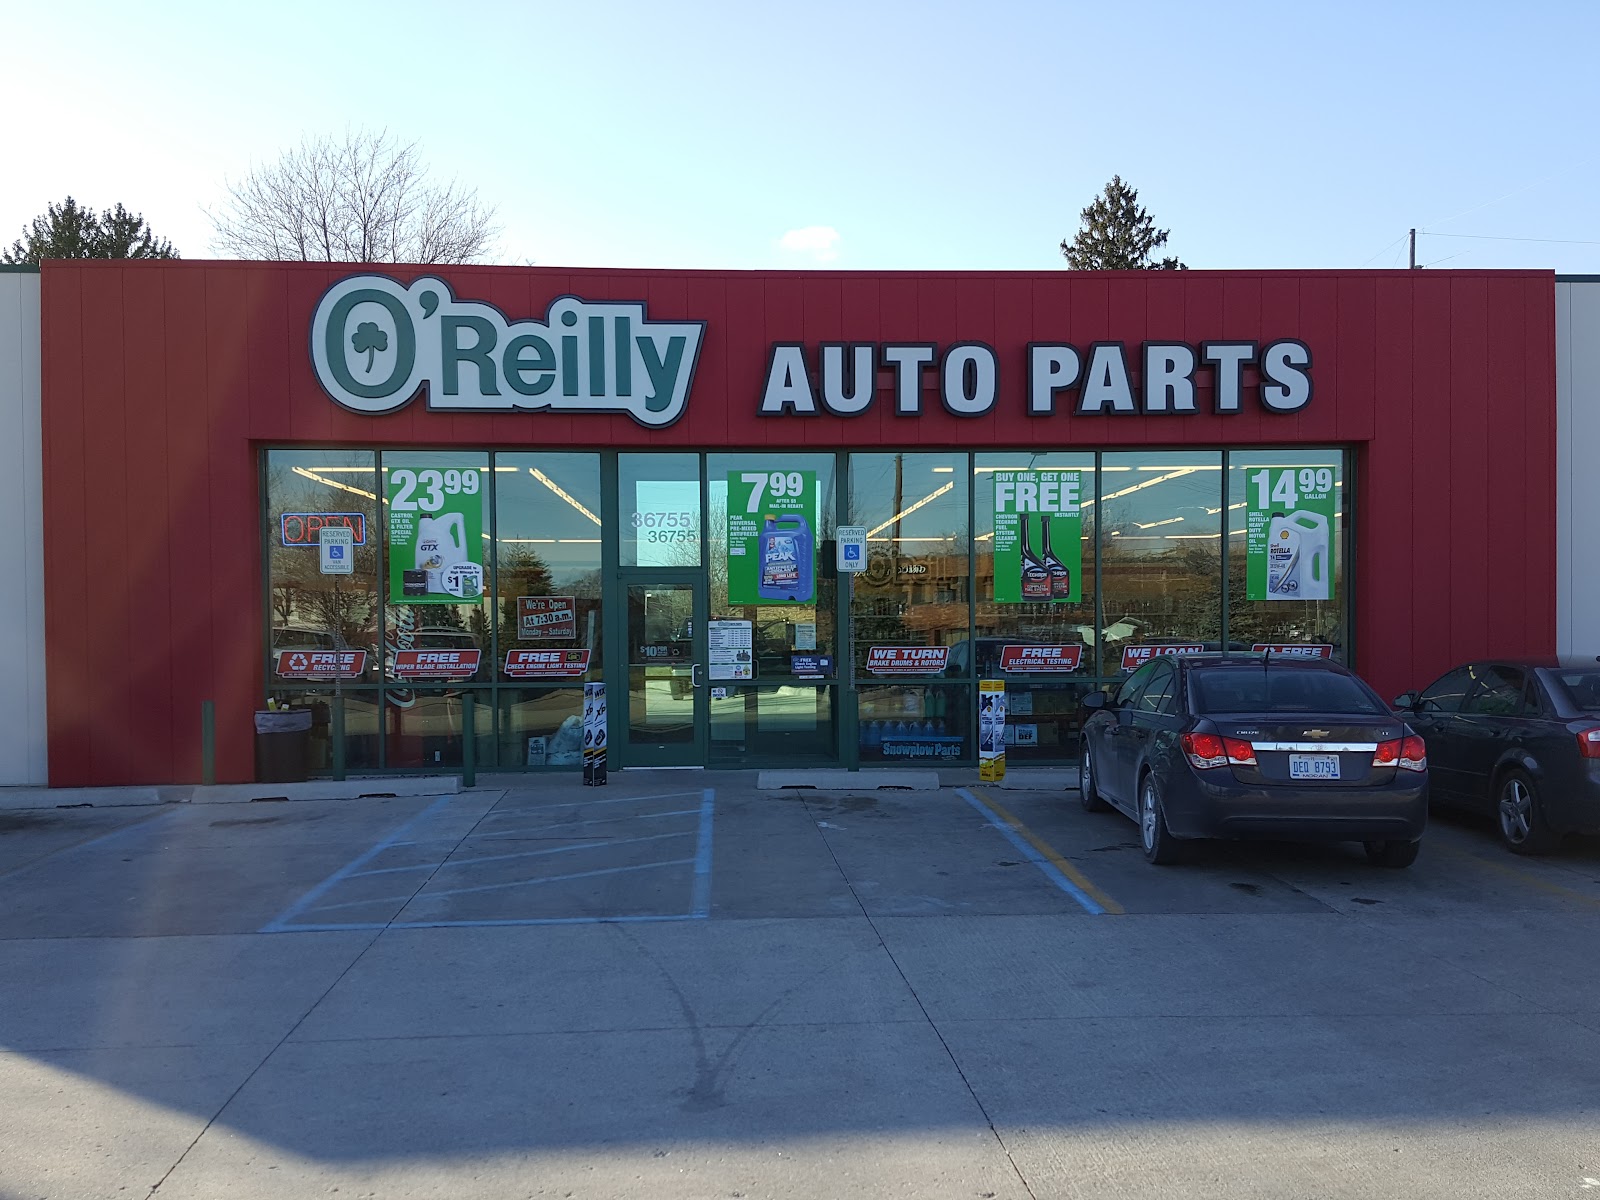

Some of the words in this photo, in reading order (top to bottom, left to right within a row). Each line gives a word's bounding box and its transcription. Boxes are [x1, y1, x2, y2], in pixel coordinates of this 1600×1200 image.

[325, 288, 687, 413] O'Reilly
[760, 344, 998, 413] AUTO
[1032, 342, 1311, 412] PARTS
[995, 472, 1015, 482] BUY
[1017, 472, 1039, 483] ONE,
[1041, 472, 1059, 482] GET
[1061, 472, 1080, 482] ONE
[995, 482, 1080, 512] FREE
[631, 512, 690, 528] 36755
[322, 530, 351, 538] RESERVED
[647, 530, 697, 543] 36755
[765, 551, 796, 563] PEAK
[447, 575, 459, 587] $1
[525, 599, 546, 609] We're
[549, 599, 567, 611] Open
[525, 617, 535, 626] At
[535, 613, 554, 624] 7:30
[554, 613, 573, 621] a.m.
[521, 628, 542, 637] Monday
[548, 627, 573, 636] Saturday
[640, 646, 657, 657] $10
[873, 649, 898, 660] WE
[901, 649, 945, 659] TURN
[1021, 647, 1063, 658] FREE
[1127, 648, 1152, 658] WE
[310, 653, 356, 664] FREE
[416, 653, 461, 663] FREE
[517, 652, 562, 663] FREE
[869, 659, 891, 667] BRAKE
[891, 659, 914, 667] DRUMS
[921, 659, 945, 667] ROTORS
[1046, 657, 1073, 665] TESTING
[883, 742, 934, 758] Snowplow
[934, 743, 961, 756] Parts
[1314, 761, 1337, 773] 8793
